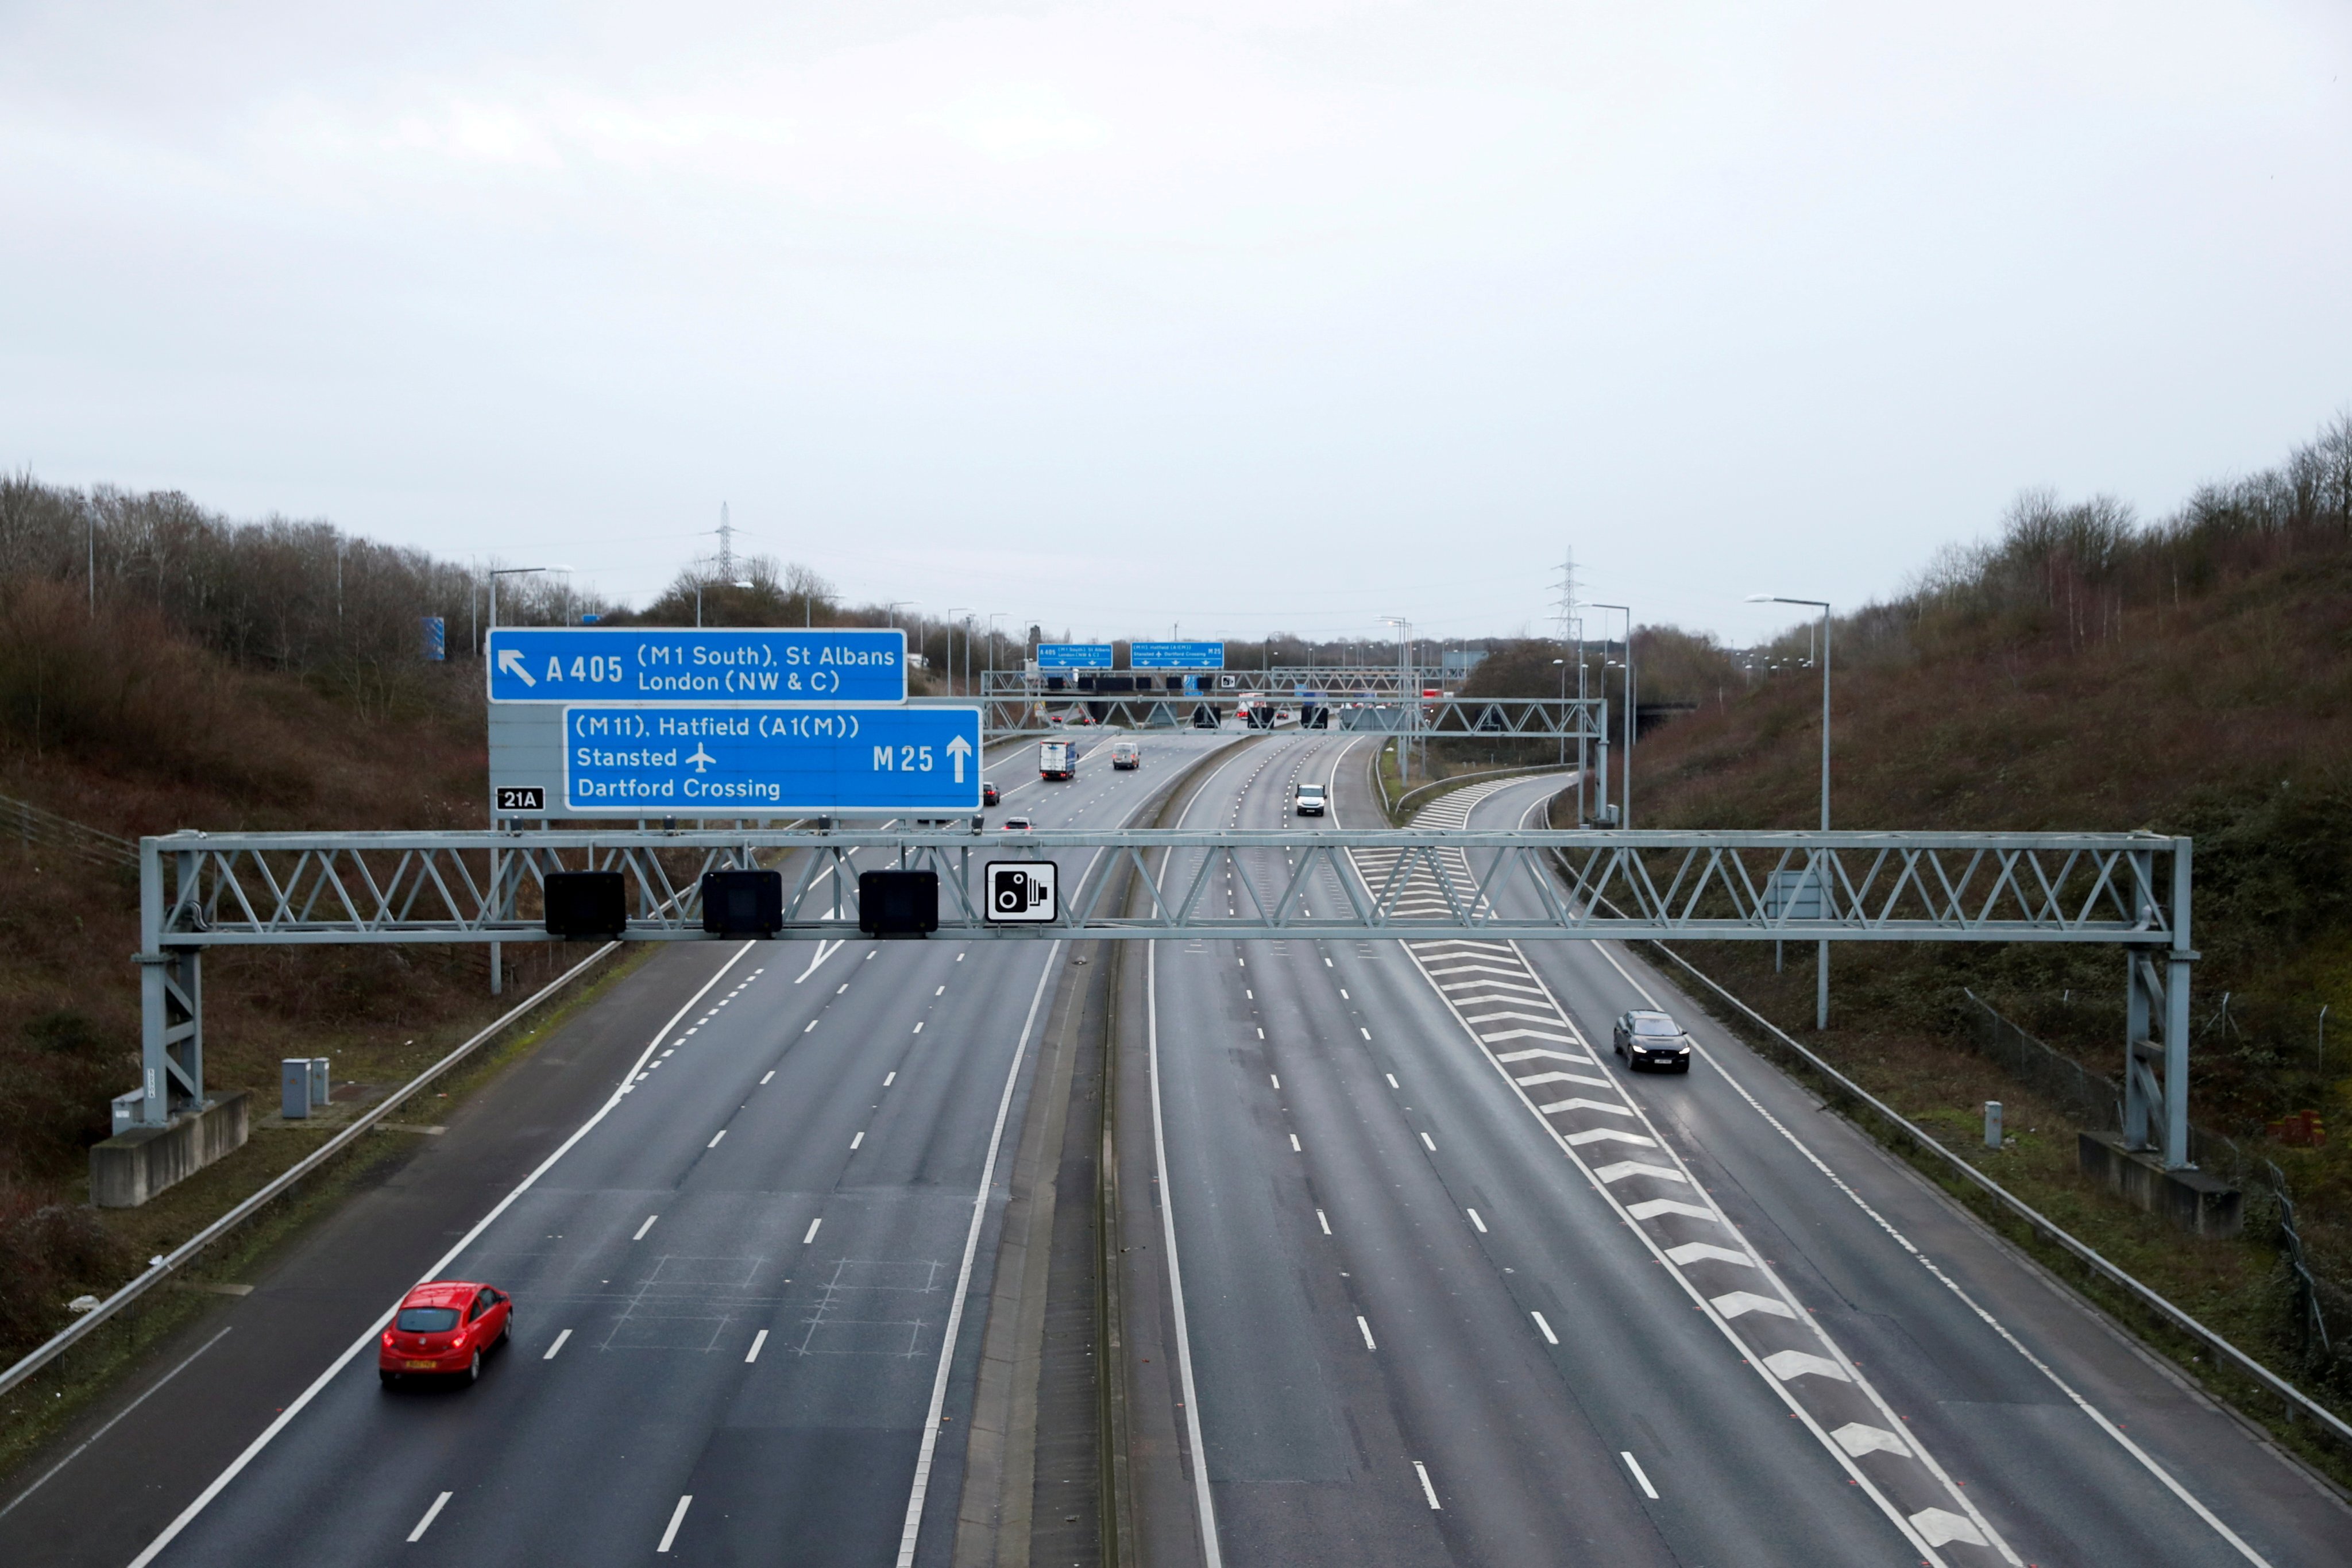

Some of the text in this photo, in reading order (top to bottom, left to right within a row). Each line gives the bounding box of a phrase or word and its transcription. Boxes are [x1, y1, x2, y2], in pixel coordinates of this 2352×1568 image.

[693, 644, 777, 667] South),
[787, 646, 810, 665] St
[820, 647, 894, 665] Albans
[639, 670, 839, 693] London (NW & C)
[660, 717, 749, 736] Hatfield
[578, 748, 677, 766] Stansted
[504, 791, 536, 806] 21A
[579, 778, 780, 801] Dartford Crossing
